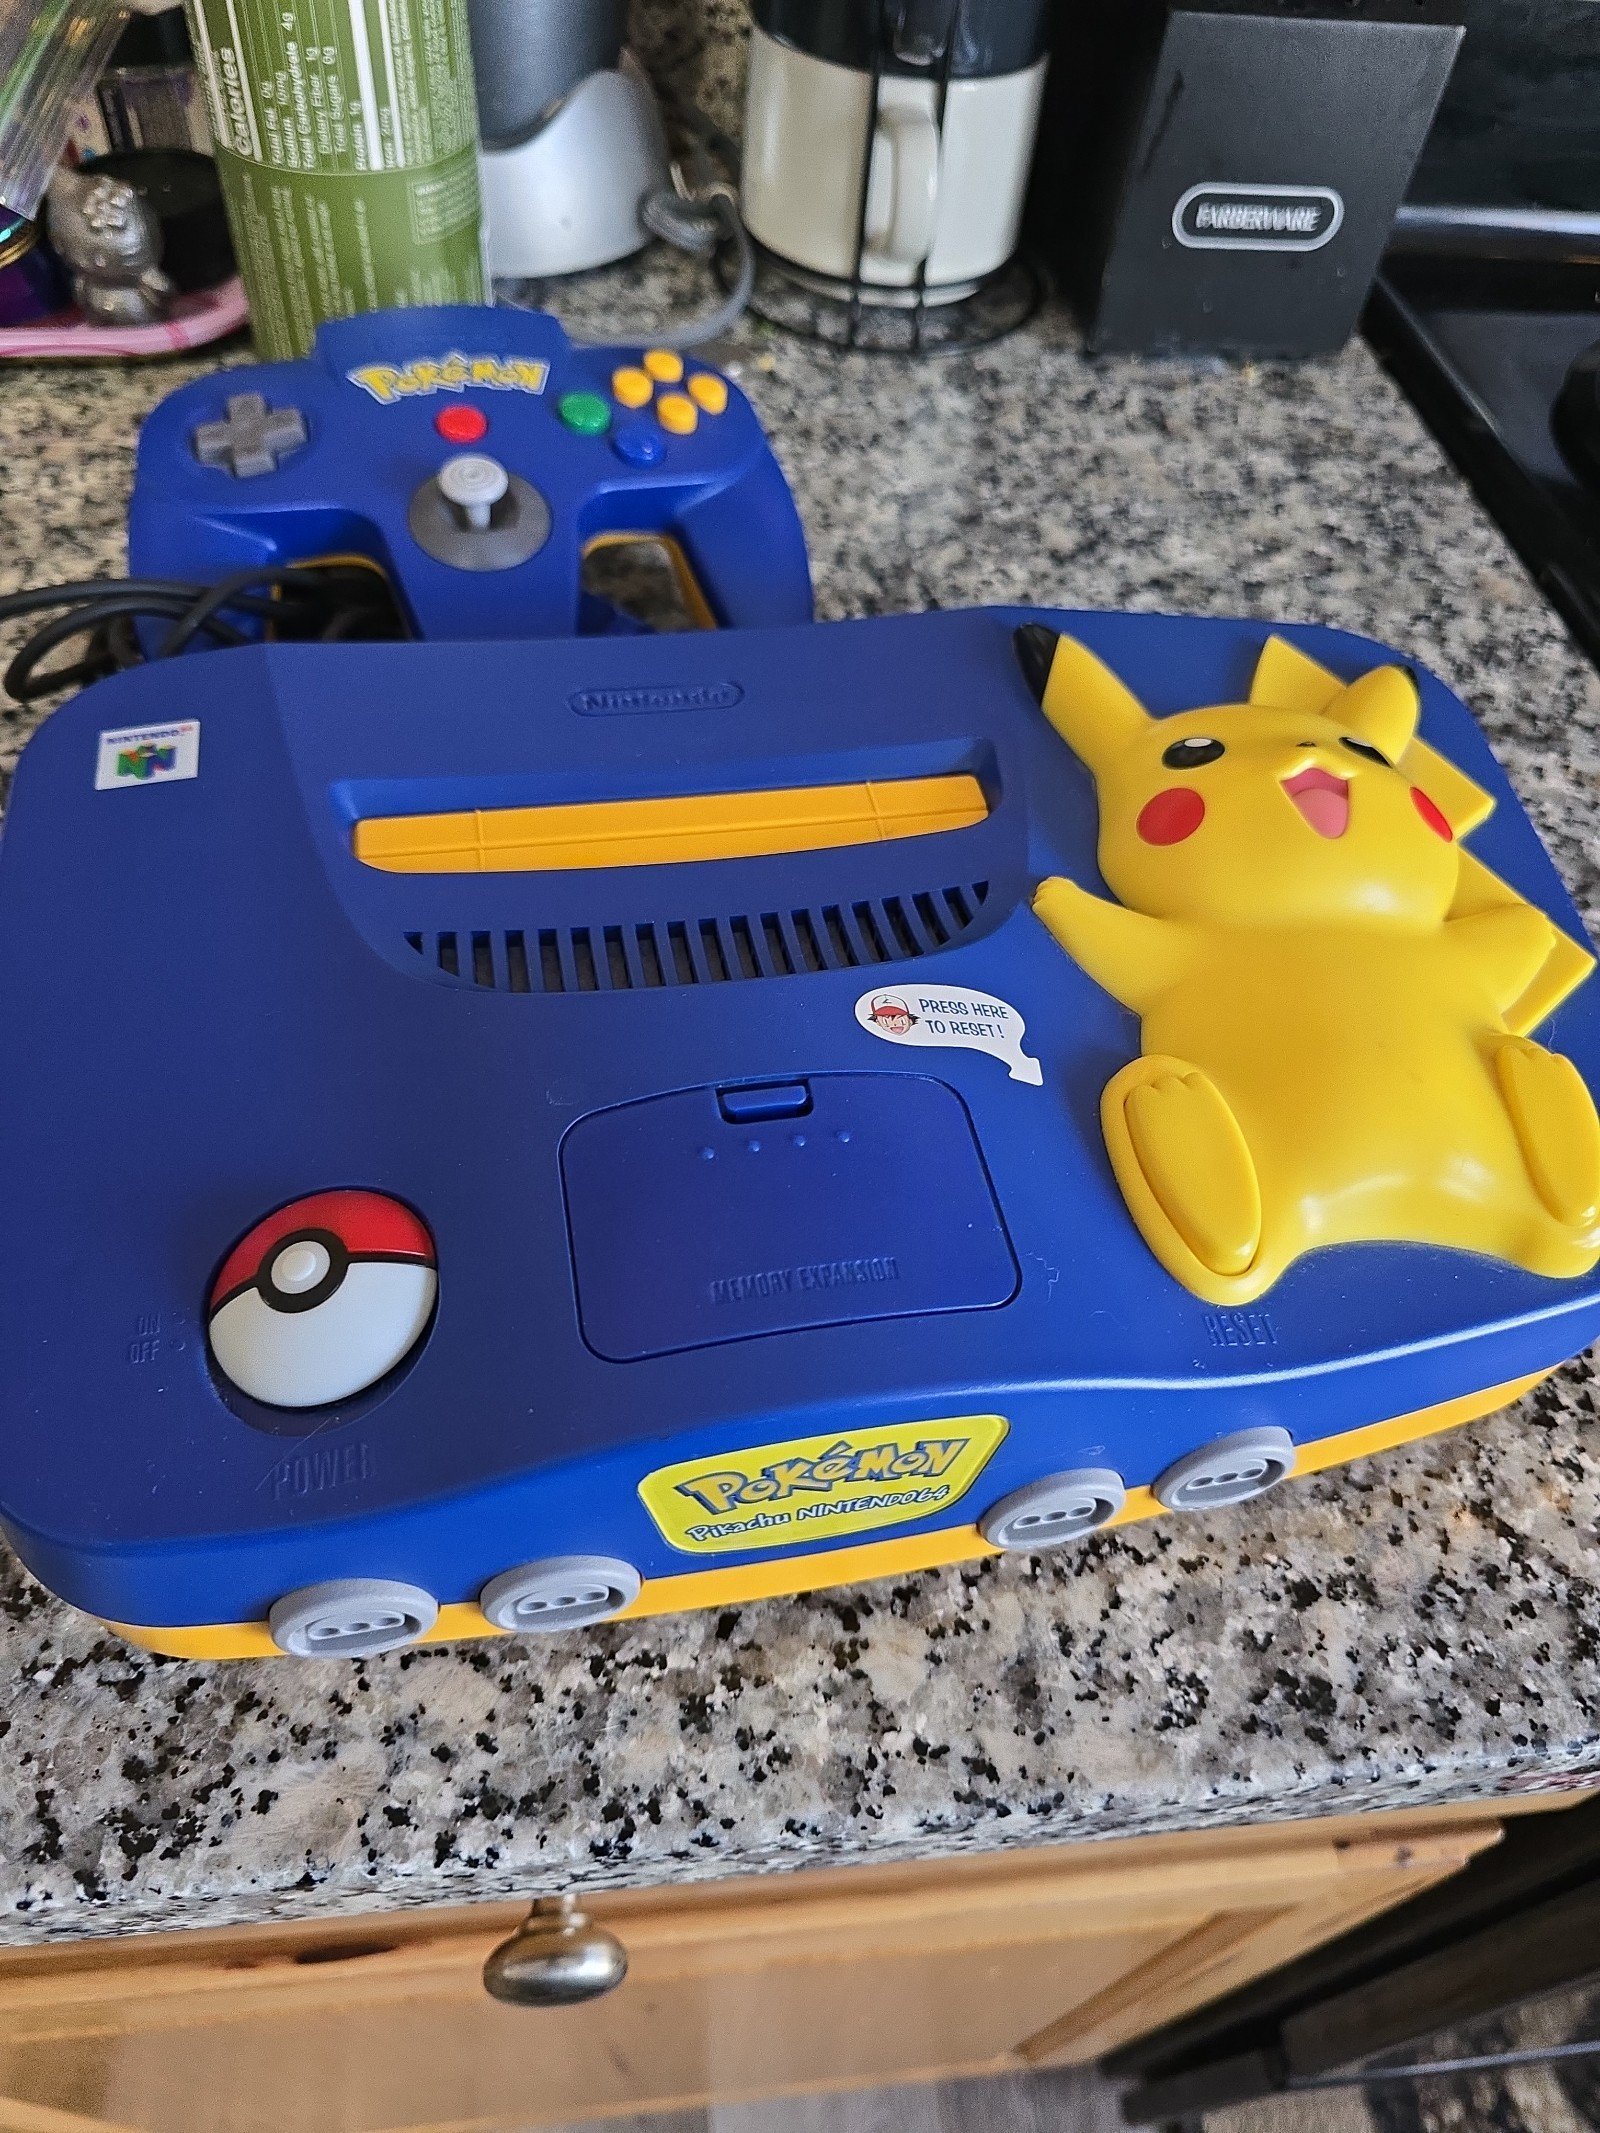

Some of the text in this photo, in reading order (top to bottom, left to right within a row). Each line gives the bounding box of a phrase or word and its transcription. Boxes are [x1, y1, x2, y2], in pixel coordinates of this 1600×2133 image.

[281, 12, 296, 31] 4g
[219, 46, 252, 155] Calories
[286, 41, 312, 135] Carbohydrate
[1196, 202, 1322, 231] FARBERWARE
[918, 998, 1010, 1020] PRESS HERE
[925, 1019, 946, 1035] TO
[709, 1256, 901, 1302] MEMORY EXPANSION
[1203, 1313, 1278, 1347] RESET
[130, 1339, 161, 1364] OFF
[685, 1509, 791, 1543] Pikachu
